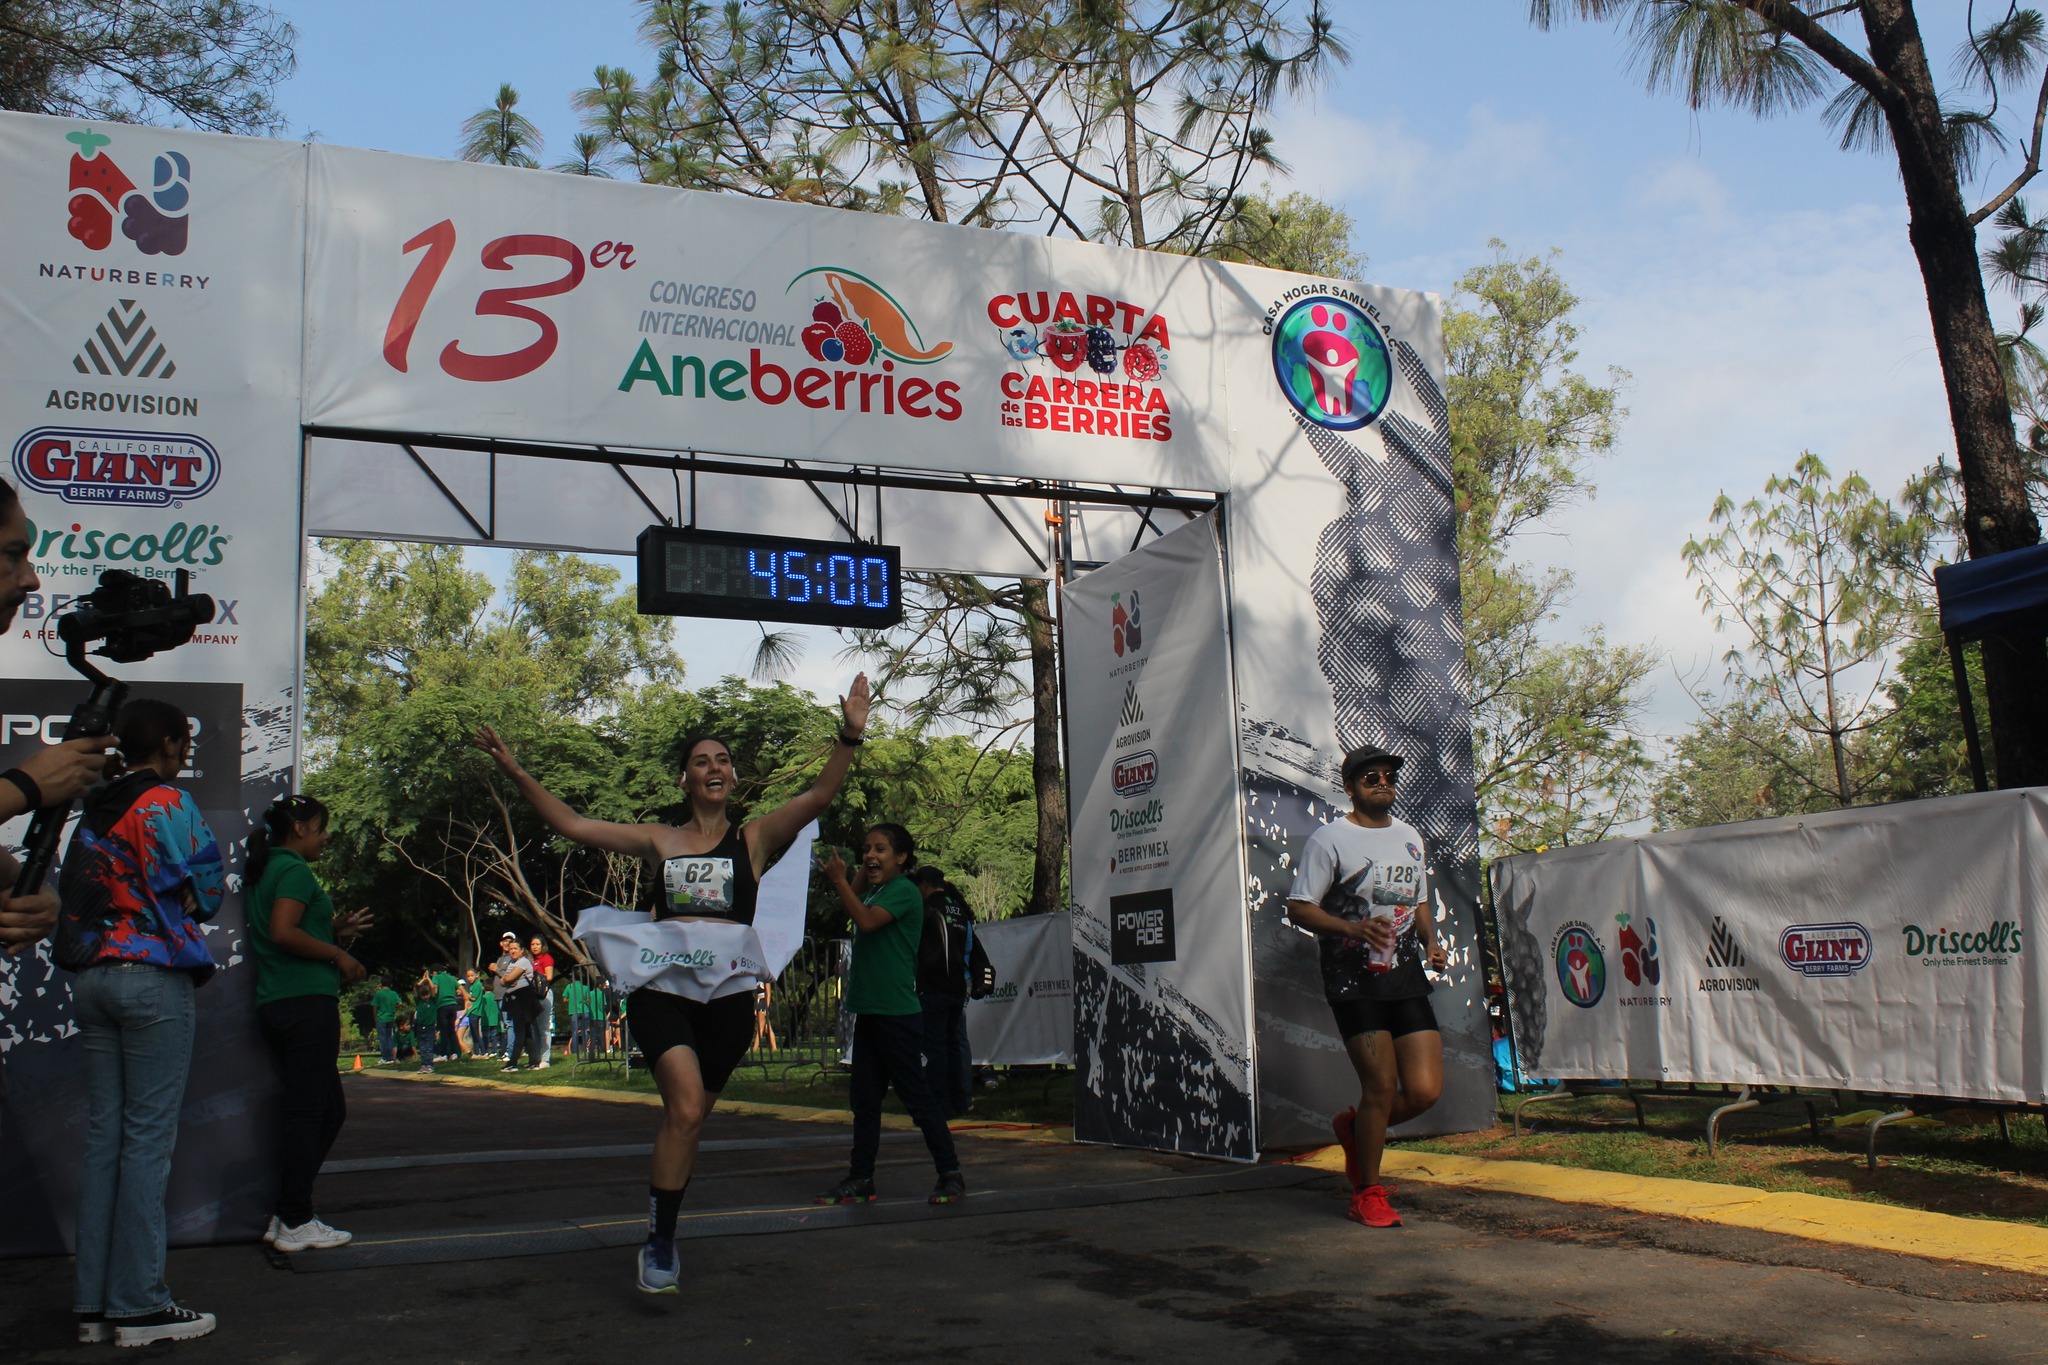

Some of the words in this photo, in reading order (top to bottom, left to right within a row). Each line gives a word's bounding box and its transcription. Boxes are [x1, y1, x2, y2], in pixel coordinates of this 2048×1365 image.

[40, 263, 209, 289] NATURBERRY
[650, 280, 757, 312] CONGRESO
[638, 310, 796, 347] INTERNACIONAL
[987, 291, 1171, 351] CUARTA
[1262, 300, 1284, 336] CASA
[1282, 284, 1328, 303] HOGAR
[1332, 286, 1381, 323] SAMUEL
[1381, 324, 1398, 352] A.C.
[618, 338, 963, 421] Aneberries
[46, 390, 198, 416] AGROVISION
[1000, 372, 1171, 414] CARRERA
[1001, 400, 1020, 413] de
[1001, 414, 1023, 427] las
[1025, 402, 1172, 442] BERRIES
[79, 440, 195, 455] CALIFORNIA
[27, 439, 202, 487] GIANT
[70, 487, 114, 499] BERRY
[119, 489, 166, 500] FARMS
[63, 563, 88, 575] the
[145, 566, 196, 579] Berrs
[749, 550, 889, 608] 45:00
[23, 630, 32, 640] A
[1109, 656, 1149, 679] NATURBERRY
[1116, 728, 1151, 749] AGROVISION
[1114, 761, 1154, 789] GIANT
[1110, 799, 1163, 832] Driscoll's
[1118, 840, 1169, 864] BERRYMEX
[685, 863, 714, 884] 62
[1386, 865, 1413, 883] 128
[1117, 909, 1164, 931] POWER
[1556, 920, 1573, 936] HOGAR
[1136, 926, 1164, 945] ADE
[1805, 931, 1859, 940] CALIFORNIA
[1902, 920, 2022, 956] Driscoll's
[640, 948, 716, 966] Driscoll's
[1785, 934, 1863, 963] GIANT
[1805, 965, 1825, 973] BERRY
[1827, 964, 1849, 972] FARMS
[1922, 957, 1941, 968] Only
[1943, 957, 1955, 966] the
[1957, 957, 1981, 966] Finest
[1983, 956, 2008, 966] Berries
[1034, 980, 1071, 991] BERRYMEX
[1698, 978, 1760, 992] AGROVISION
